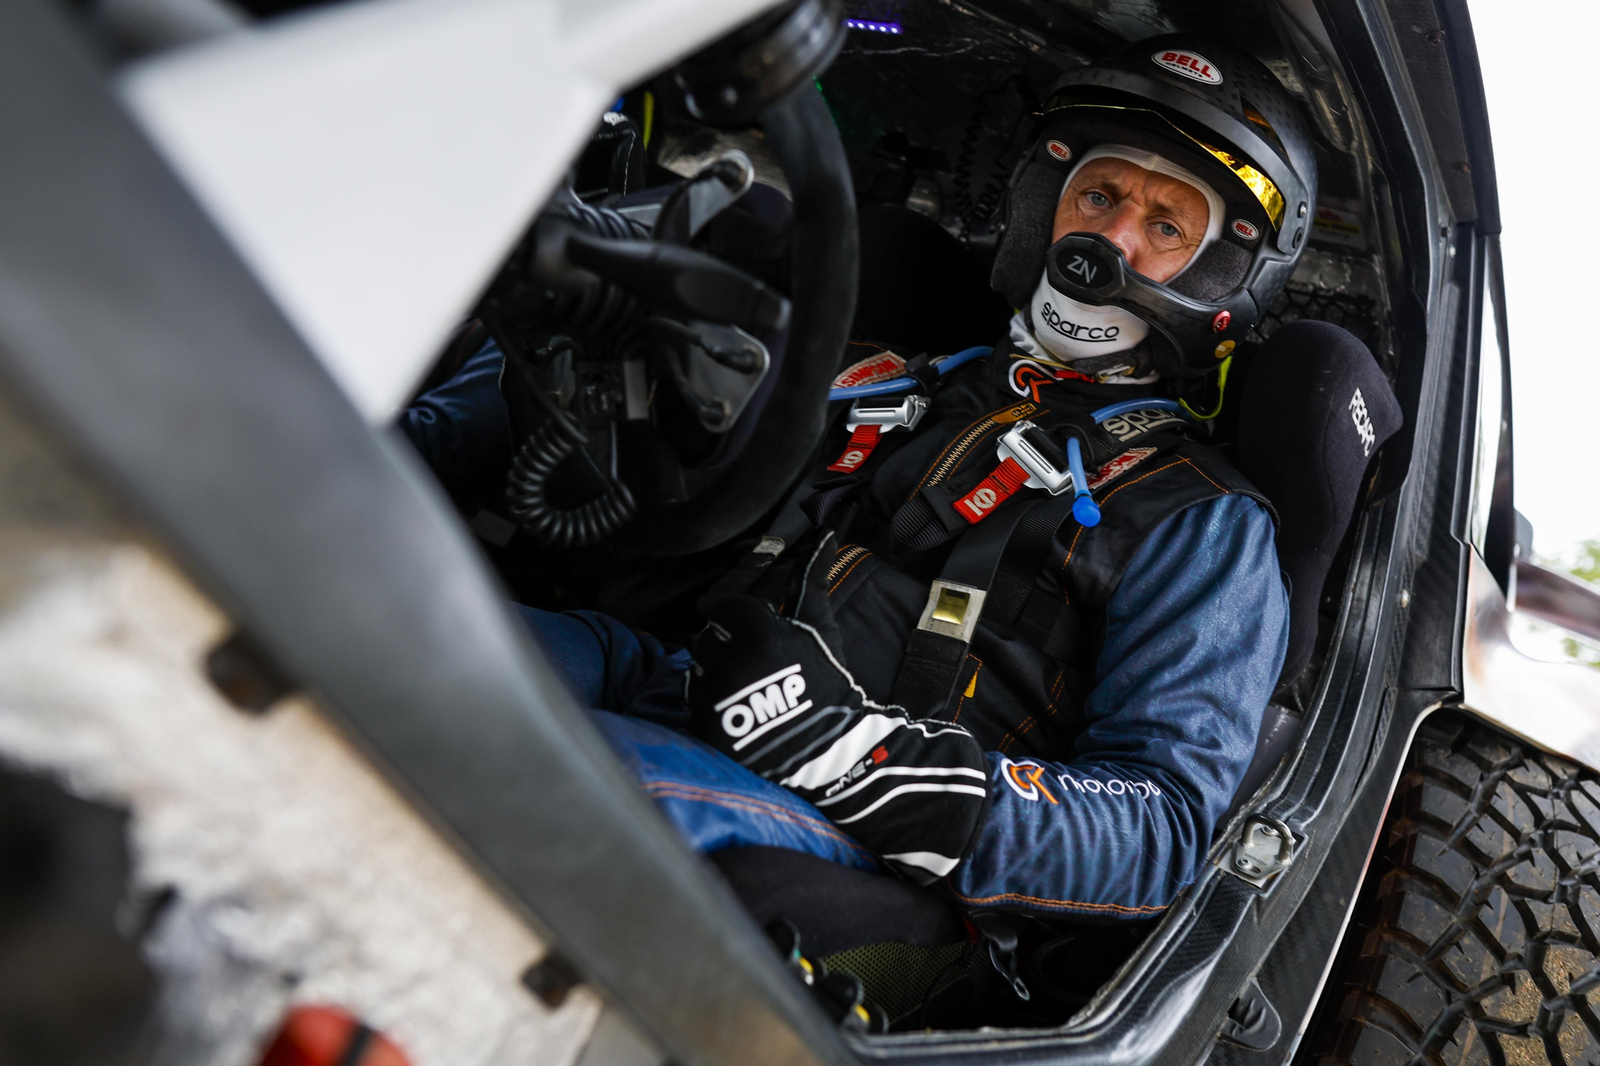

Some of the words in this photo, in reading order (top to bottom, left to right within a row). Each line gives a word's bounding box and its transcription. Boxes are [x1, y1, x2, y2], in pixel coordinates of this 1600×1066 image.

[1161, 51, 1212, 79] BELL
[1049, 143, 1067, 159] BELL
[1235, 222, 1253, 237] BELL
[1041, 302, 1120, 341] sparco
[841, 359, 900, 387] SIMPSON
[721, 673, 807, 738] OMP
